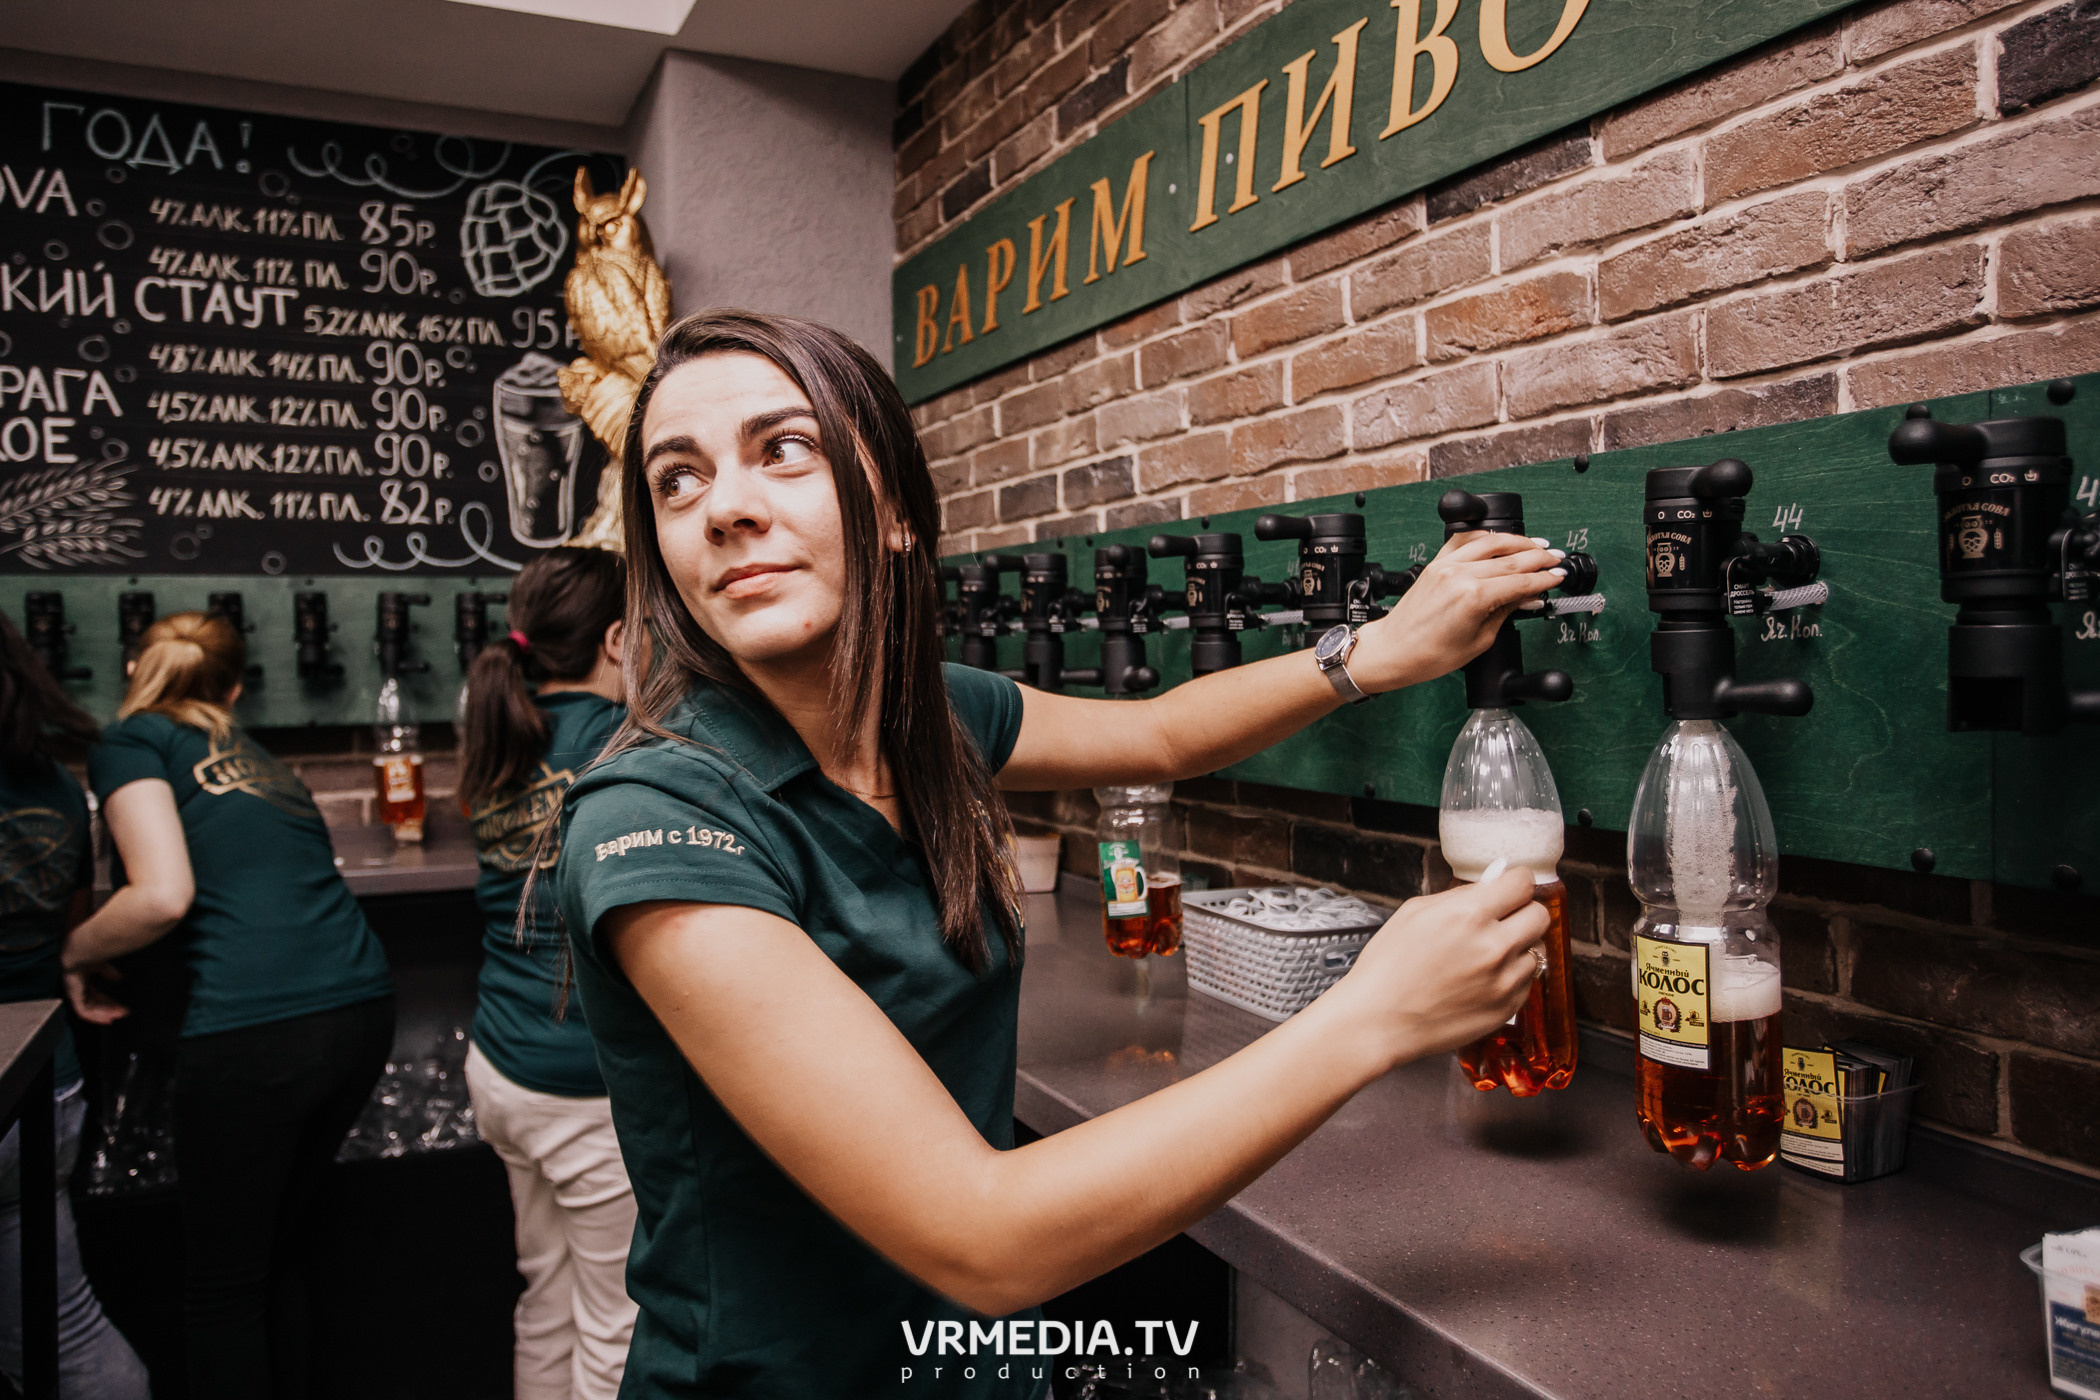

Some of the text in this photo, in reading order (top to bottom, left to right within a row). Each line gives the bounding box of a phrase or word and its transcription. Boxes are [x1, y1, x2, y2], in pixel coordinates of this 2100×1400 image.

[41, 101, 252, 175] ГОДА!
[0, 163, 79, 217] VA
[912, 150, 1155, 368] ВАРИМ
[0, 261, 301, 329] КИЙ СТАУТ
[0, 365, 124, 417] РАГА
[0, 415, 79, 464] ОЕ
[2075, 475, 2100, 507] 4
[1772, 502, 1804, 533] 44
[1408, 542, 1428, 562] 42
[1566, 527, 1589, 552] 43
[1638, 967, 1705, 996] КОЛОС
[1645, 962, 1690, 978] Ячменный
[1783, 1075, 1835, 1098] ОЛОС
